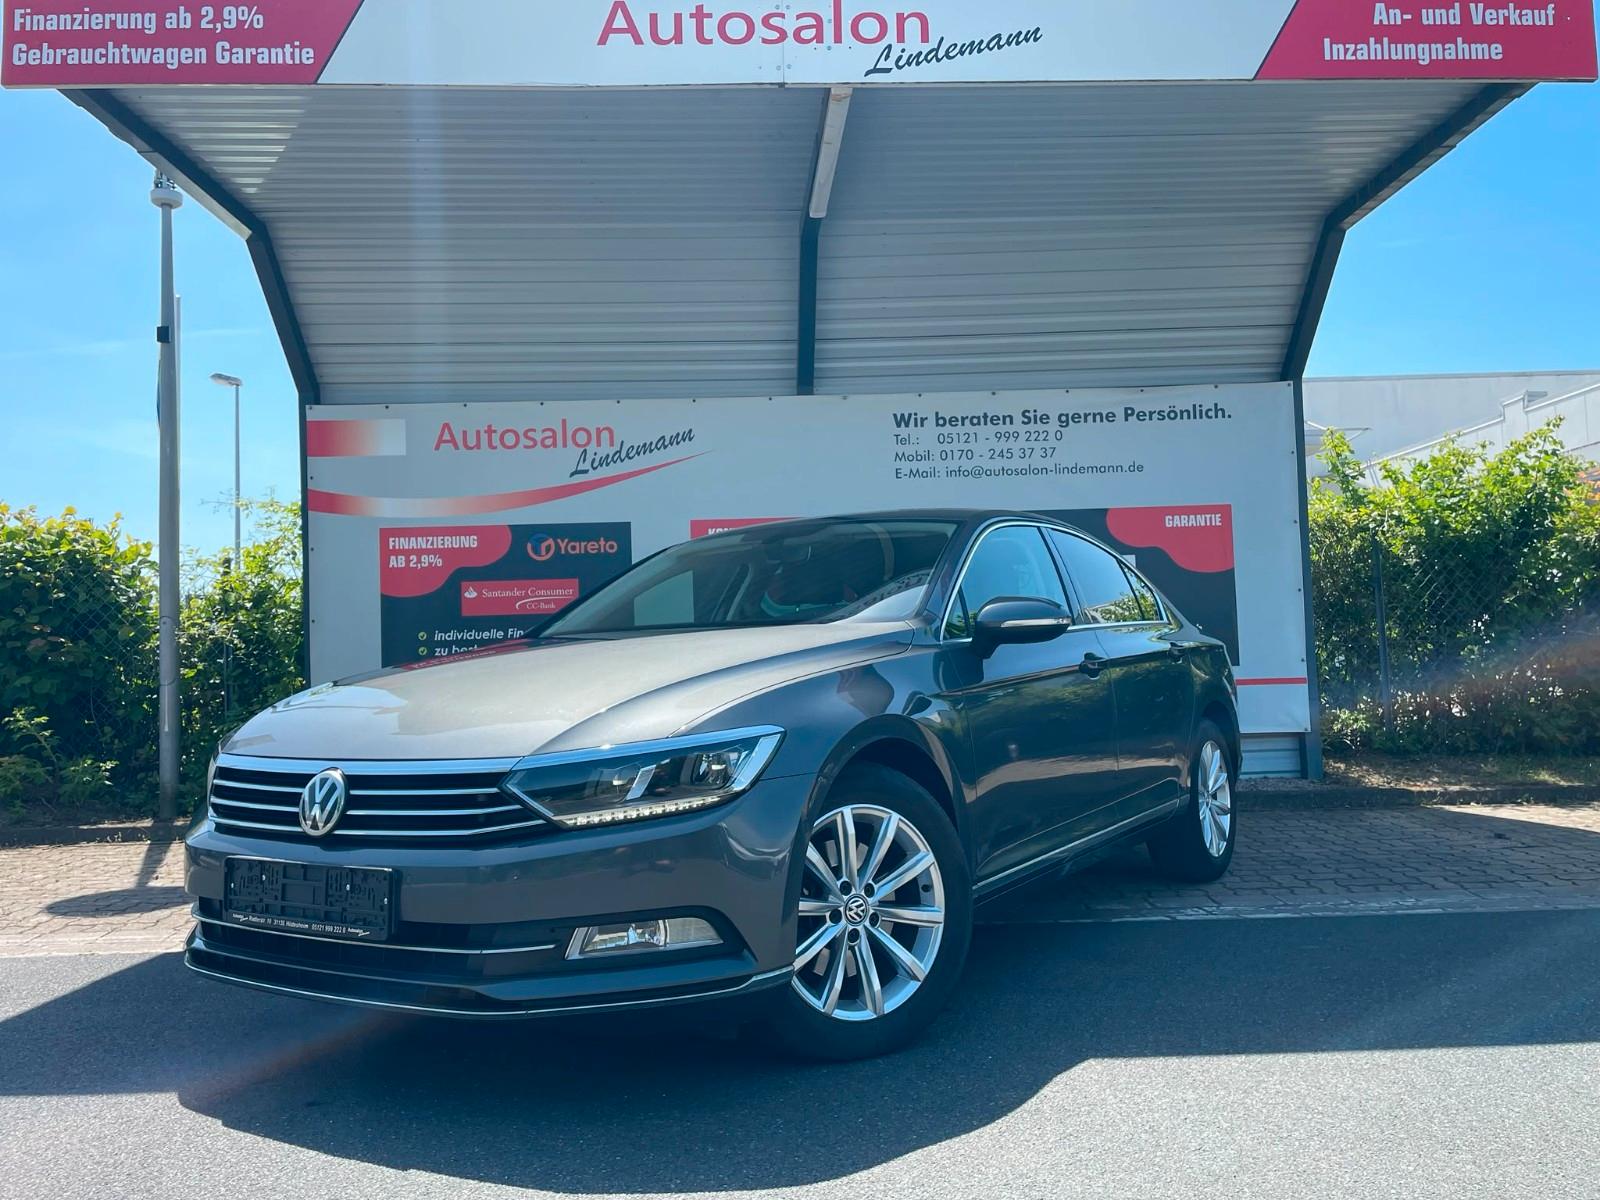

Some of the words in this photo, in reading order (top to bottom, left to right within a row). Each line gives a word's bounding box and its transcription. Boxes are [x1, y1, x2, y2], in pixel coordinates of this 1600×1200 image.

[13, 7, 156, 34] Finanzierung
[165, 6, 191, 29] ab
[200, 5, 264, 33] 2,9%
[596, 0, 930, 45] Autosalon
[1373, 3, 1412, 25] An-
[1421, 3, 1461, 25] und
[1470, 3, 1555, 26] Verkauf
[12, 41, 207, 69] Gebrauchtwagen
[215, 41, 314, 65] Garantie
[864, 26, 1043, 77] Lindemann
[1323, 37, 1503, 65] Inzahlungnahme
[893, 412, 928, 428] Wir
[935, 411, 1014, 427] beraten
[1021, 409, 1050, 425] Sie
[1057, 411, 1116, 428] gerne
[1124, 403, 1232, 422] Persönlich.
[434, 418, 615, 451] Autosalon
[894, 434, 919, 446] Tel.:
[937, 432, 978, 445] 05121
[995, 430, 1019, 443] 999
[1025, 430, 1049, 442] 222
[1054, 430, 1063, 441] 0
[569, 428, 695, 478] Lindemann
[894, 449, 935, 462] Mobil:
[940, 449, 974, 461] 0170
[988, 448, 1014, 460] 245
[1019, 447, 1035, 459] 37
[1040, 446, 1057, 458] 37
[895, 466, 940, 479] E-Mail:
[946, 461, 1144, 479] info@autosalon-lindemann.de
[1165, 513, 1222, 527] GARANTIE
[389, 535, 478, 550] FINANZIERUNG
[557, 537, 618, 554] Yareto
[389, 556, 405, 568] AB
[409, 555, 442, 569] 2,9%
[482, 588, 525, 598] Santander
[528, 587, 574, 597] Consumer
[434, 629, 504, 641] individuelle
[434, 648, 448, 656] zu
